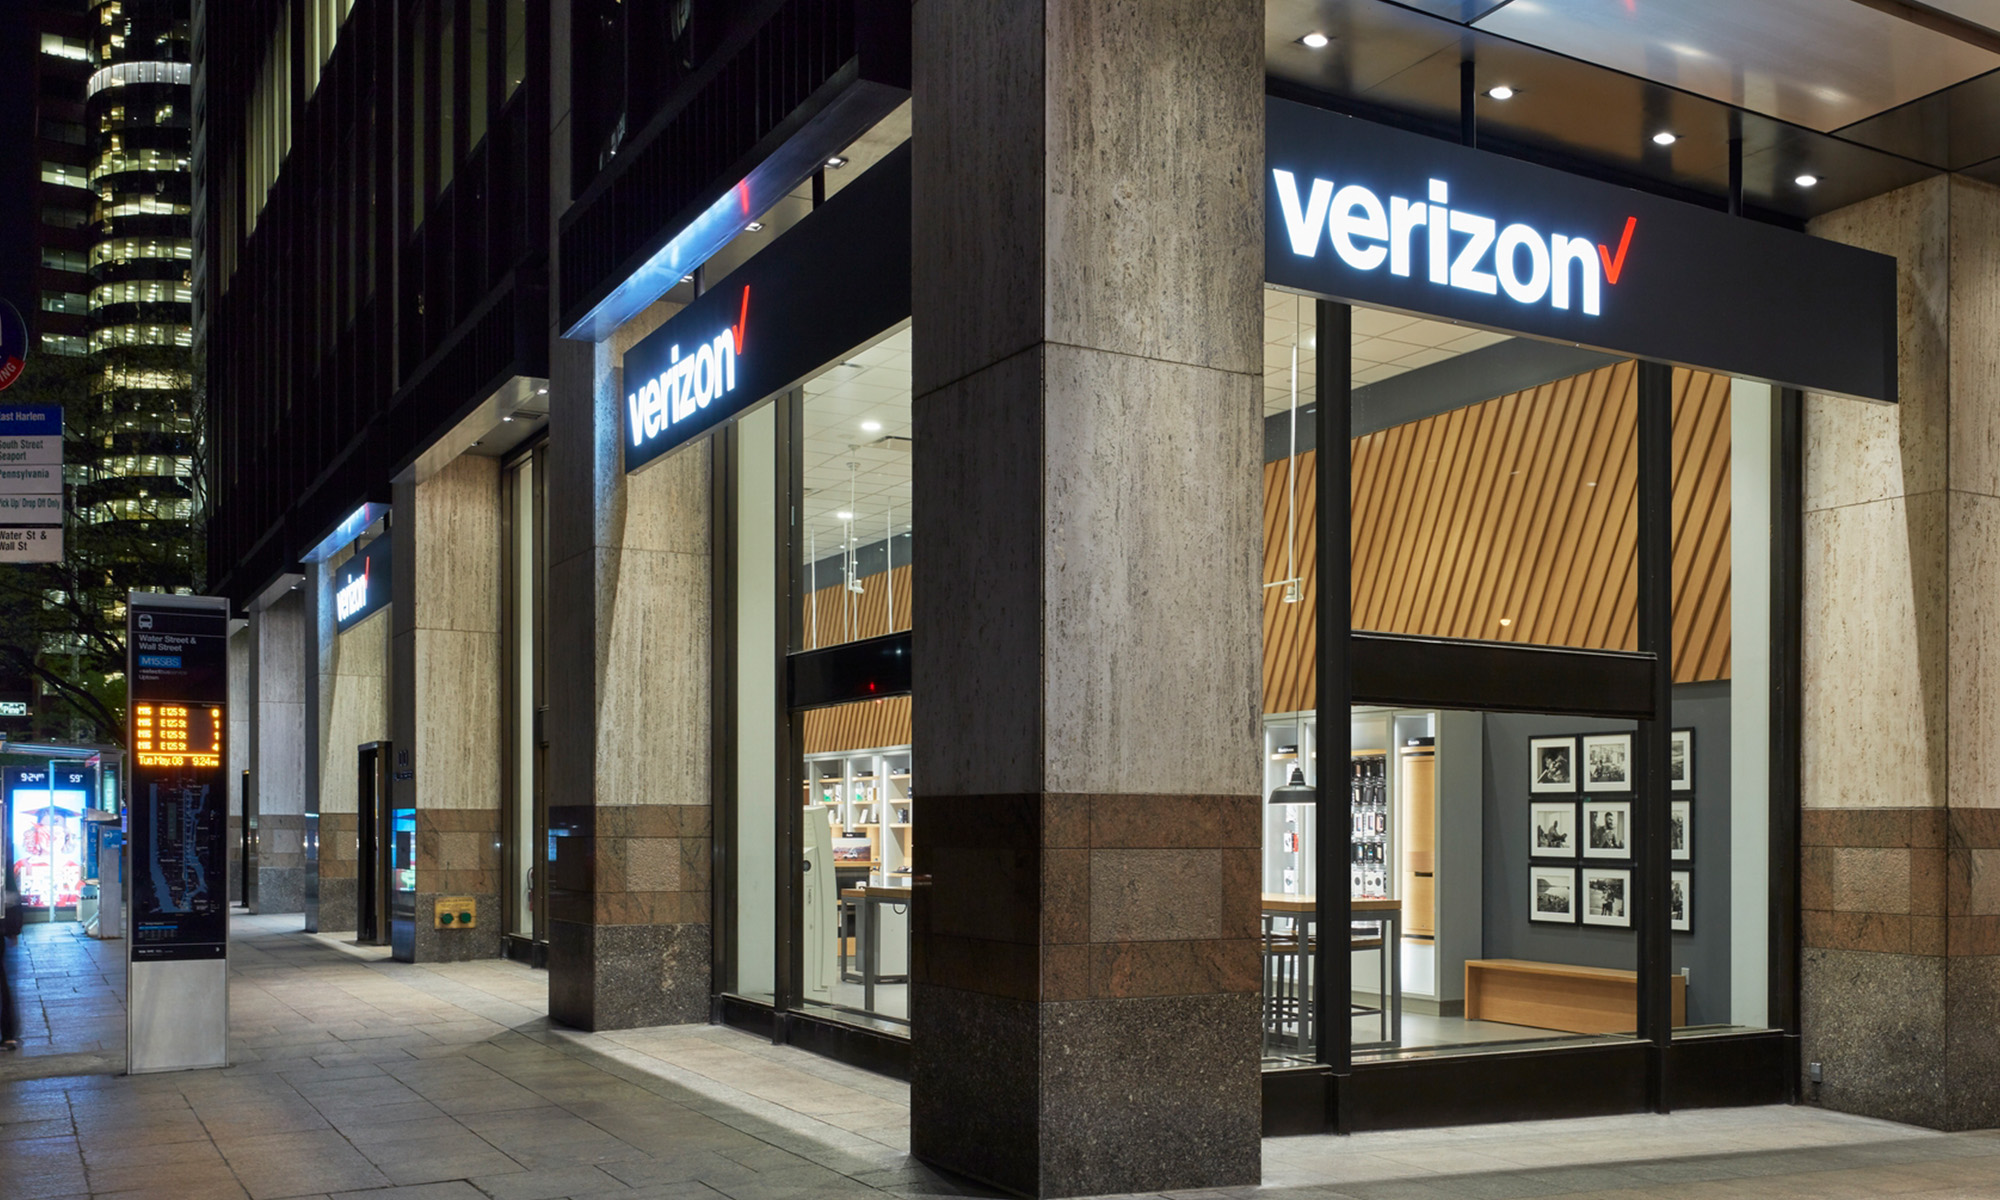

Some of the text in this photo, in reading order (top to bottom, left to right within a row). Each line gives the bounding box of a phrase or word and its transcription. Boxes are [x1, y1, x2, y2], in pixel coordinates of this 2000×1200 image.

[1272, 168, 1600, 316] verizon
[629, 328, 735, 446] verizon
[0, 411, 46, 421] ast Harlem
[20, 439, 44, 449] Street
[0, 469, 50, 480] ennsylvania
[22, 498, 36, 509] Drop
[38, 498, 46, 508] Off
[47, 498, 60, 510] Only
[26, 530, 36, 540] St
[40, 530, 47, 540] &
[18, 541, 28, 551] St
[336, 573, 367, 622] verizon
[138, 634, 197, 645] Water Street &
[138, 642, 183, 652] Wall Street
[211, 708, 220, 718] 0
[214, 720, 220, 730] 1
[214, 732, 220, 741] 1
[211, 743, 220, 753] 4
